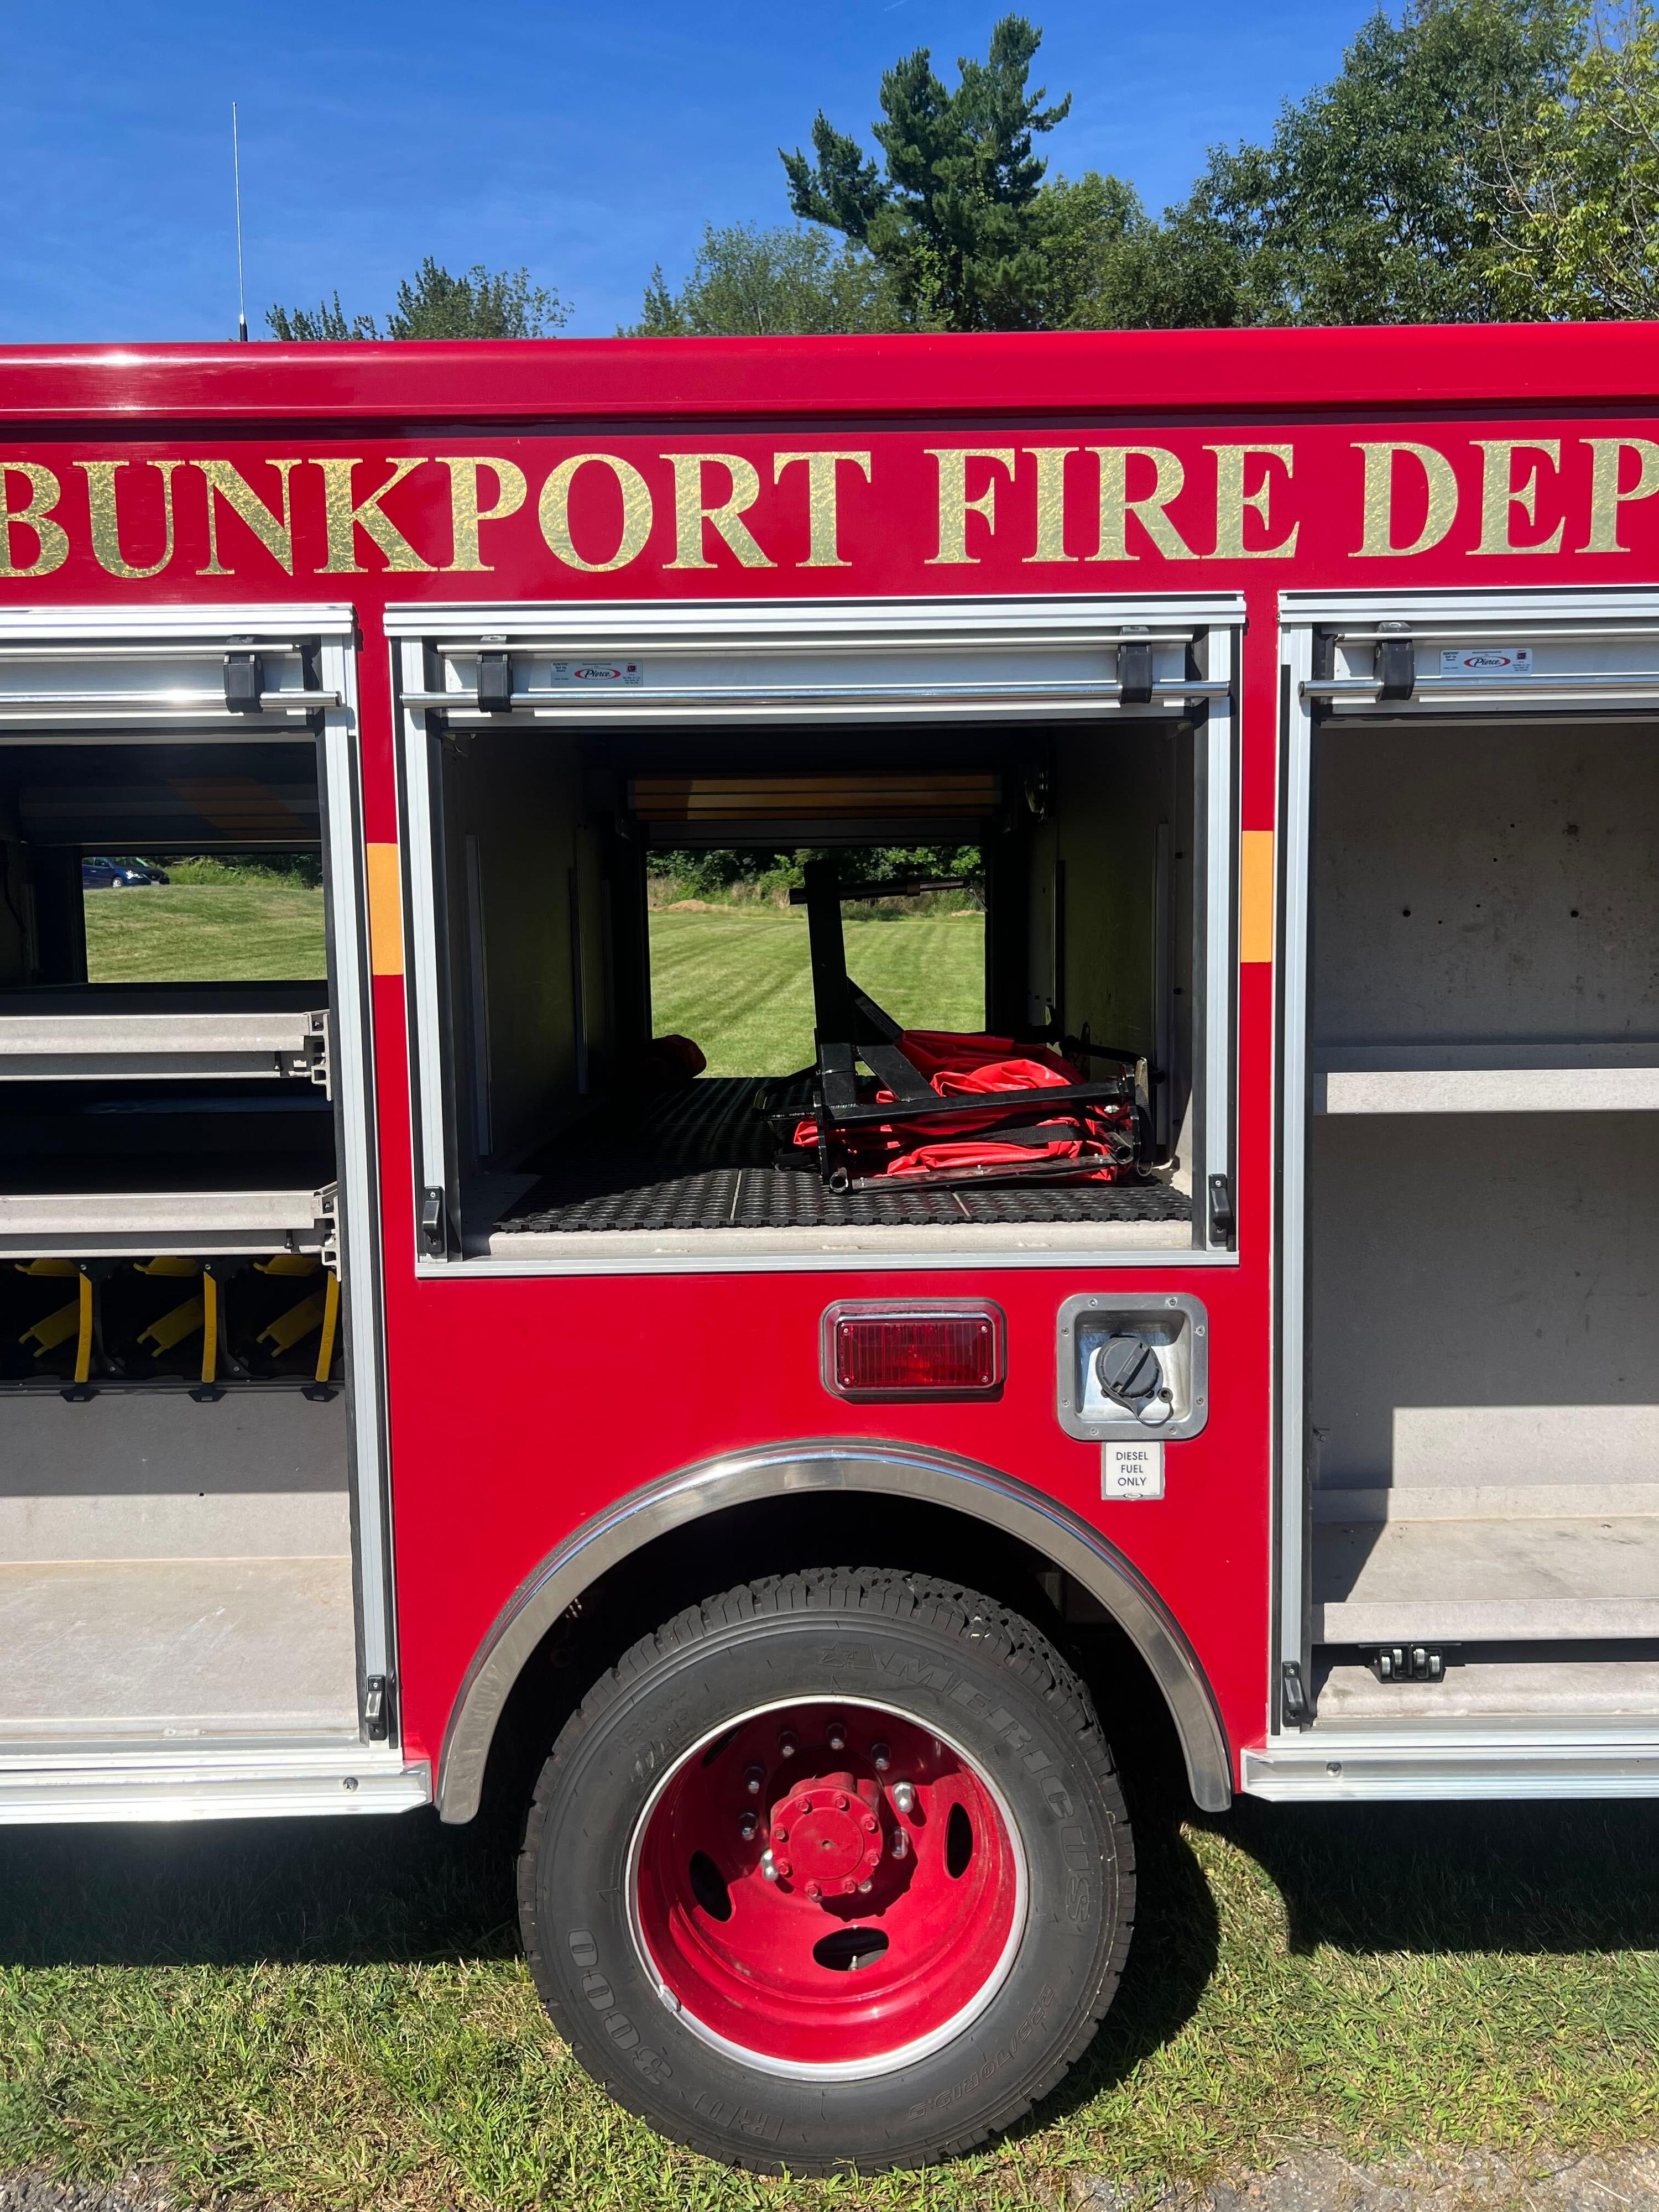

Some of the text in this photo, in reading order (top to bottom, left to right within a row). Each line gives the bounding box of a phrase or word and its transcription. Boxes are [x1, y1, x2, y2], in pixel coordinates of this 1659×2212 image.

[0, 437, 1659, 579] BUNKPORT FIRE DEP
[1473, 658, 1500, 667] Pierce
[584, 669, 610, 679] Pierce
[1116, 1452, 1149, 1460] DIESEL
[1121, 1464, 1144, 1473] FUEL
[1118, 1477, 1146, 1486] ONLY
[568, 1929, 672, 2085] 3000
[908, 1983, 1054, 2121] 225/70R19.5
